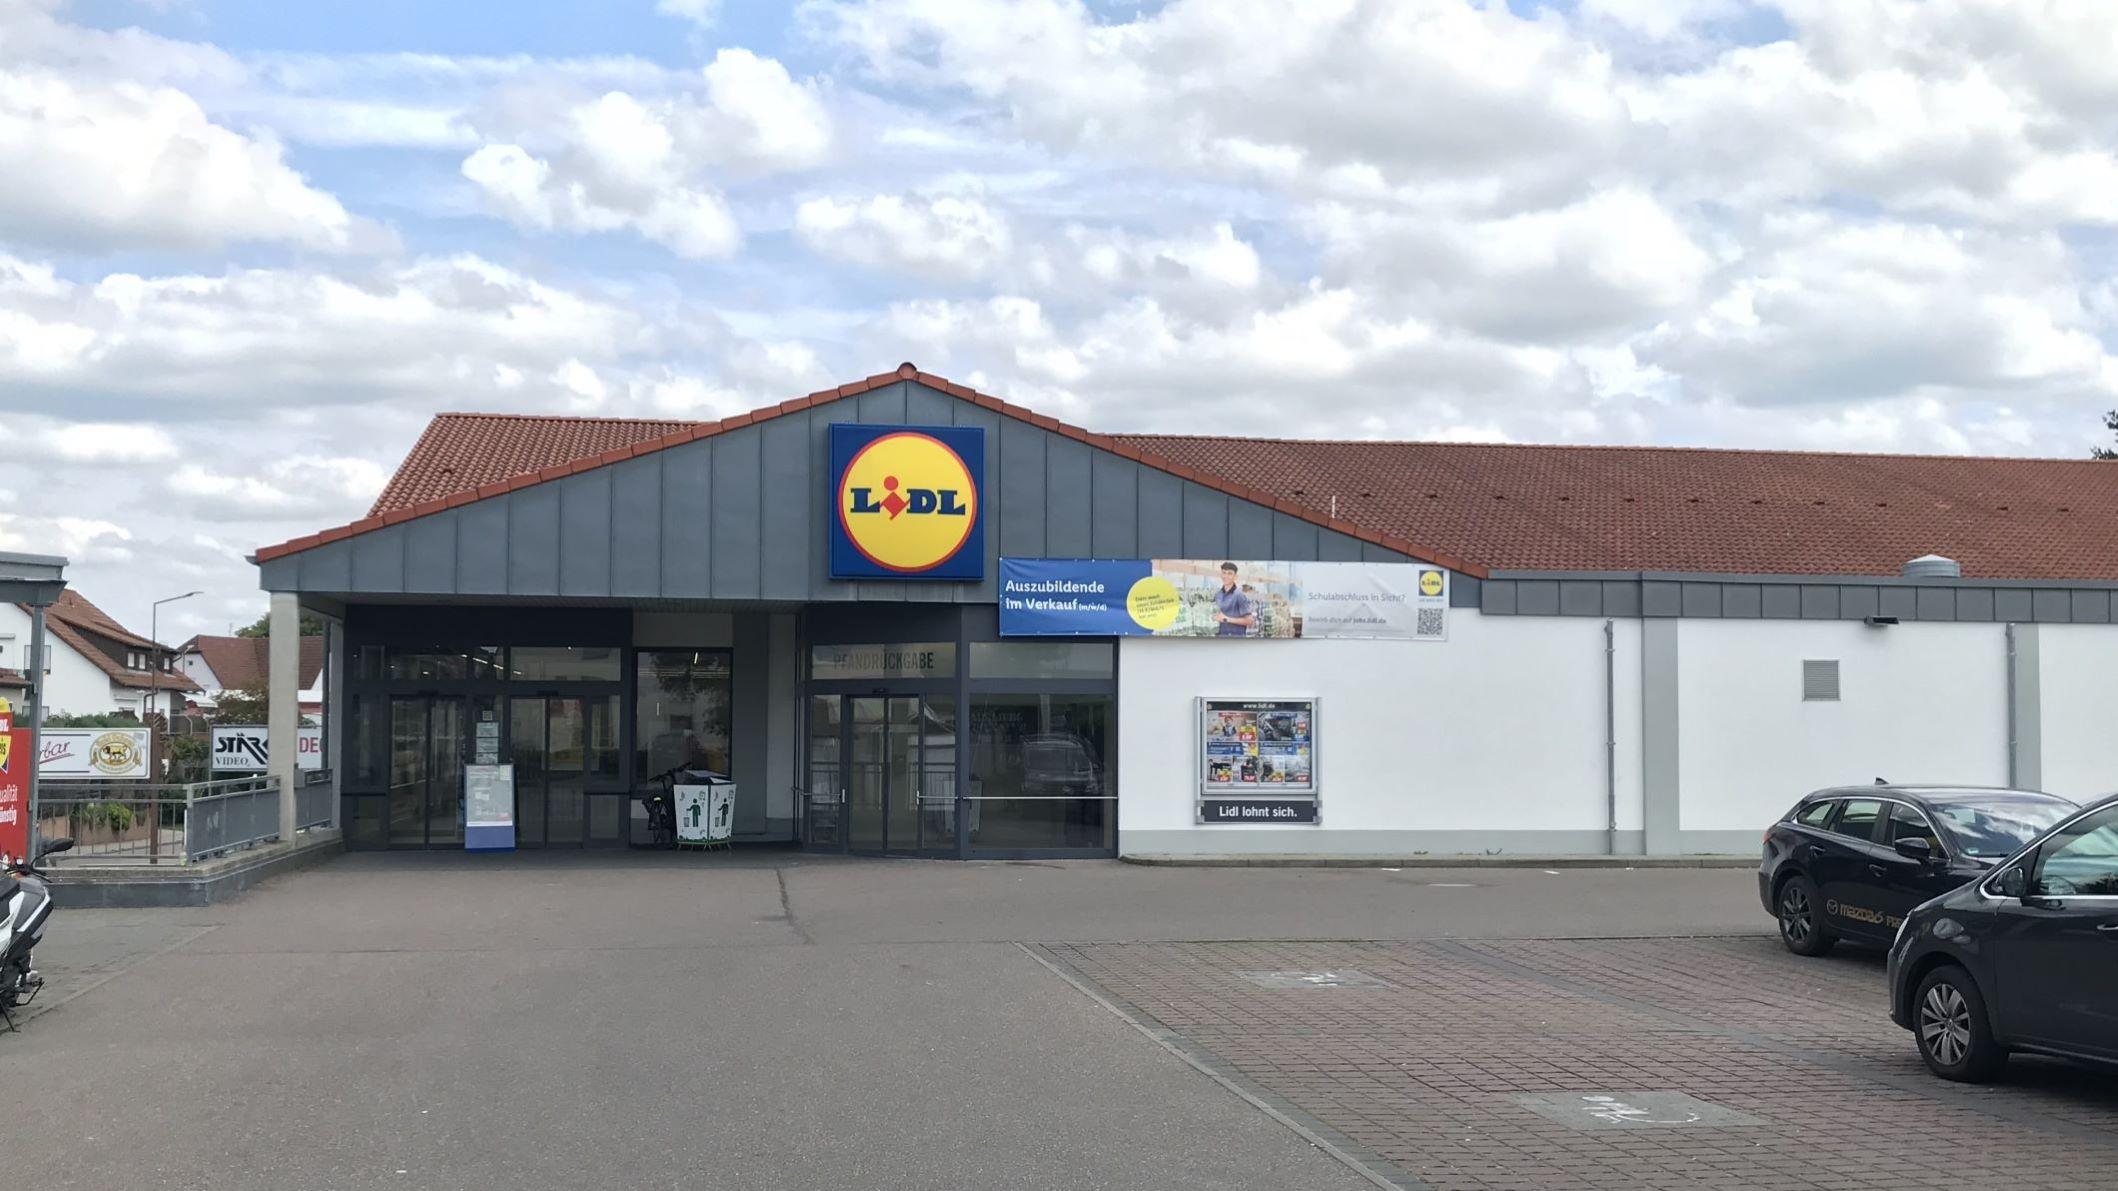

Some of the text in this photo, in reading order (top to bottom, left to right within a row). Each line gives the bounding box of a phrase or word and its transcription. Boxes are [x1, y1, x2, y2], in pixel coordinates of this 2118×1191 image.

[1005, 580, 1105, 593] Auszubildende
[1005, 597, 1022, 610] im
[1025, 597, 1078, 610] Verkauf
[1219, 805, 1298, 817] Lidl lohnt sich.
